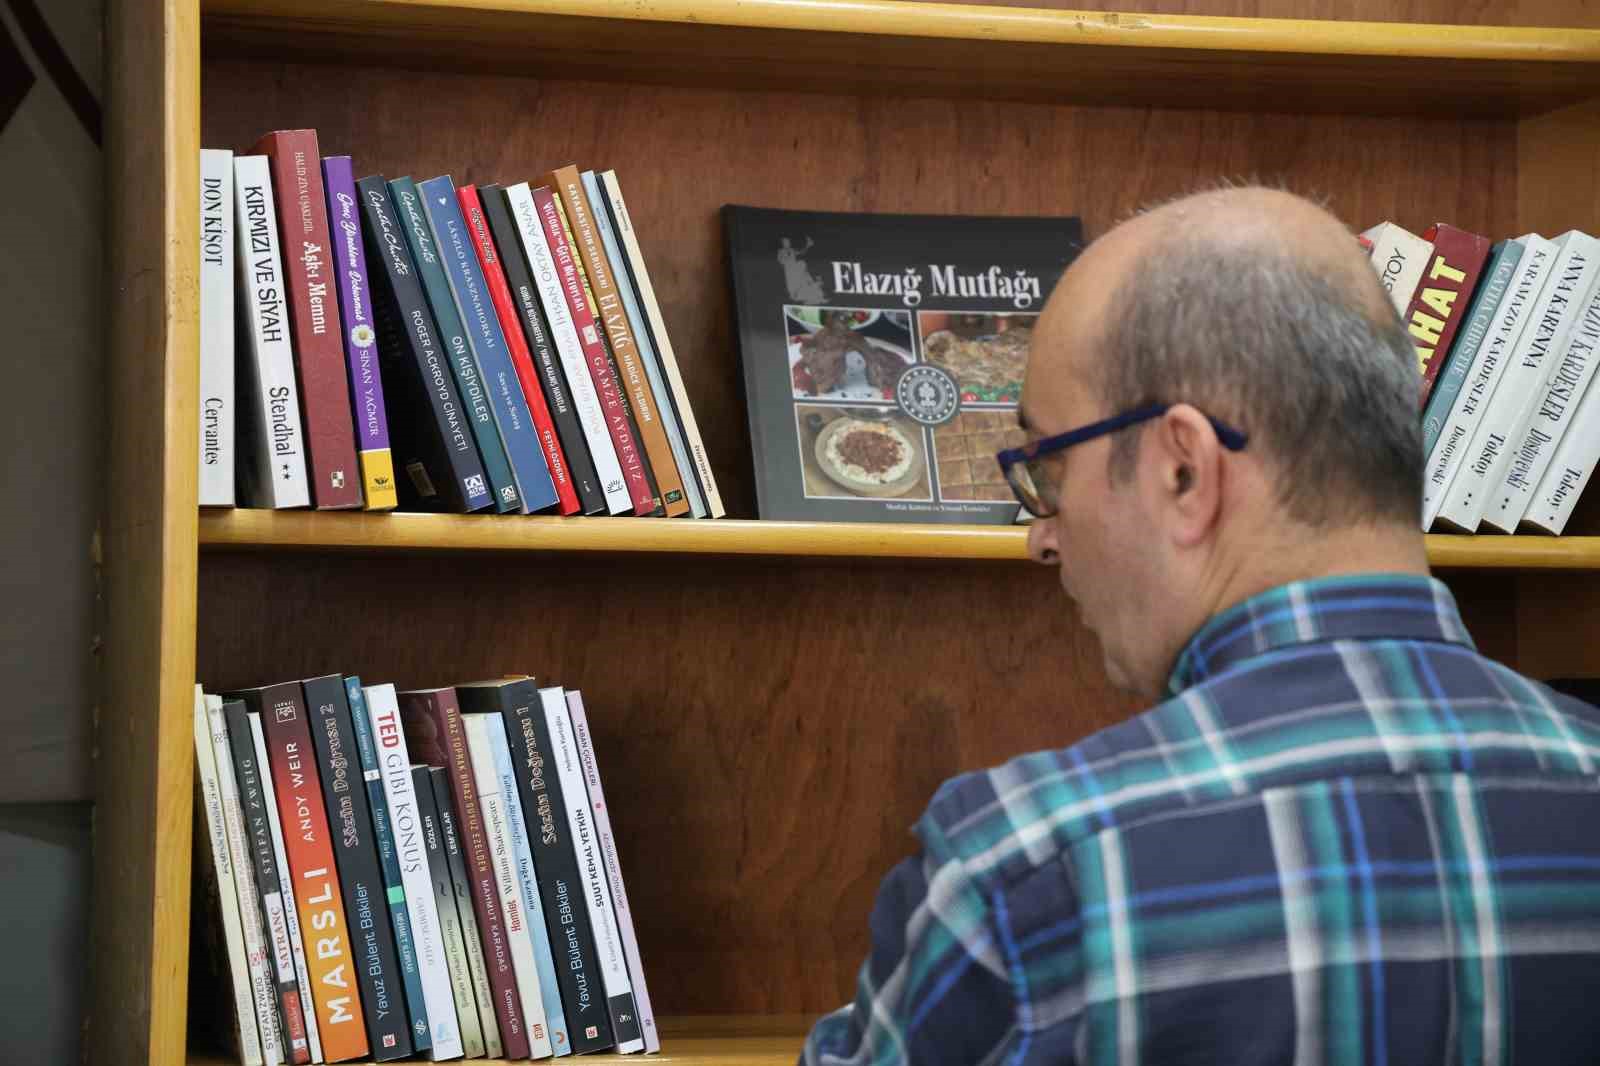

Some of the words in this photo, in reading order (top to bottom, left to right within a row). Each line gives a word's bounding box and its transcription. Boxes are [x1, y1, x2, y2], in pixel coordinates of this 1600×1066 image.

[202, 177, 221, 211] DON
[245, 184, 270, 252] KIRMIZI
[199, 212, 225, 265] KİŞOT
[300, 241, 322, 278] Aşk-ı
[255, 258, 274, 283] VE
[831, 260, 922, 306] Elazığ
[928, 264, 1041, 308] Mutfağı
[1384, 247, 1407, 291] STOY
[1481, 258, 1514, 317] AGATHA
[1499, 250, 1547, 335] KARAMAZOV
[1557, 251, 1586, 292] ANNA
[258, 288, 282, 342] SİYAH
[306, 280, 331, 335] Memnu
[600, 294, 630, 348] ELAZIĞ
[1407, 256, 1467, 376] AHAT
[1522, 294, 1569, 369] KARENİNA
[450, 334, 465, 354] ON
[1452, 316, 1489, 377] CHRISTIE
[409, 309, 431, 347] ROGER
[424, 348, 449, 401] ACKROYD
[442, 401, 467, 450] CİNAYETİ
[457, 355, 488, 423] KİŞİYDİLER
[1462, 335, 1507, 416] KARDEŞLER
[1538, 339, 1594, 423] KARDEŞLER
[205, 398, 222, 465] Cervantes
[269, 387, 295, 456] Stendhal
[593, 355, 617, 408] GAMZE
[613, 415, 641, 480] AYDENİZ
[1431, 424, 1466, 486] Dostoyevski
[1470, 432, 1506, 478] Tolstoy
[1504, 427, 1552, 493] Dostoyevski
[1546, 466, 1583, 509] Tolstoy
[318, 702, 334, 715] 2
[515, 705, 529, 715] 1
[284, 741, 303, 787] WEIR
[324, 717, 348, 792] Doğrusu
[243, 758, 259, 809] ZWEIG
[376, 711, 400, 749] TED
[395, 803, 420, 872] KONUŞ
[295, 794, 314, 841] ANDY
[423, 814, 436, 849] SÖZLER
[488, 799, 504, 855] Shakespeare
[574, 808, 589, 844] YETKİN
[254, 817, 271, 874] STEFAN
[583, 845, 597, 879] KEMAL
[498, 856, 512, 895] William
[590, 879, 604, 907] SUUT
[480, 878, 496, 922] MAHMUT
[504, 898, 521, 932] Hamlet
[303, 867, 352, 1023] MARSLI
[361, 930, 381, 976] Bülent
[563, 926, 583, 970] Bülent
[256, 977, 267, 1008] ZWEIG
[374, 979, 389, 1019] Yavuz
[575, 972, 591, 1011] Yavuz
[261, 1009, 274, 1050] STEFAN
